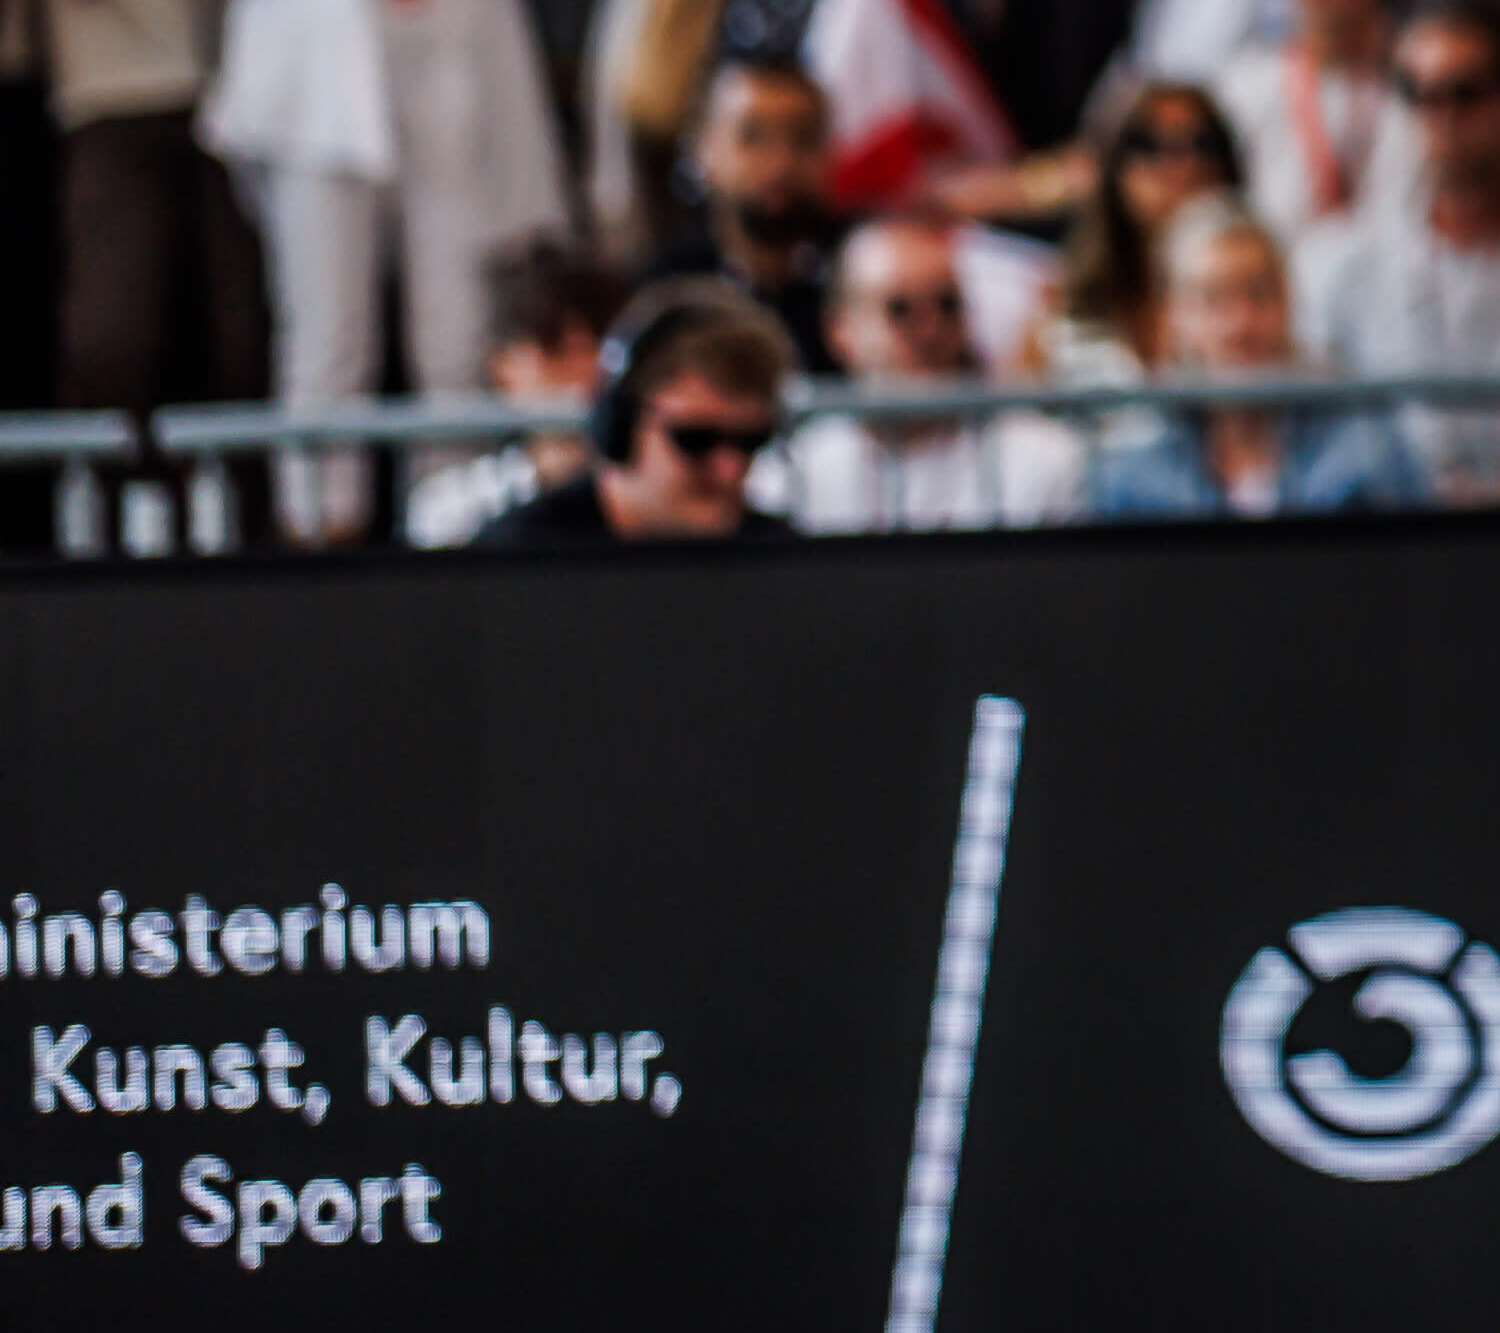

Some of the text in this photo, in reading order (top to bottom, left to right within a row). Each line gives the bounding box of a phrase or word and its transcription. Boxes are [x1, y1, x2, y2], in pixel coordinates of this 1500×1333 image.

[32, 1005, 683, 1126] Kunst, Kultur,
[178, 1153, 443, 1271] Sport
